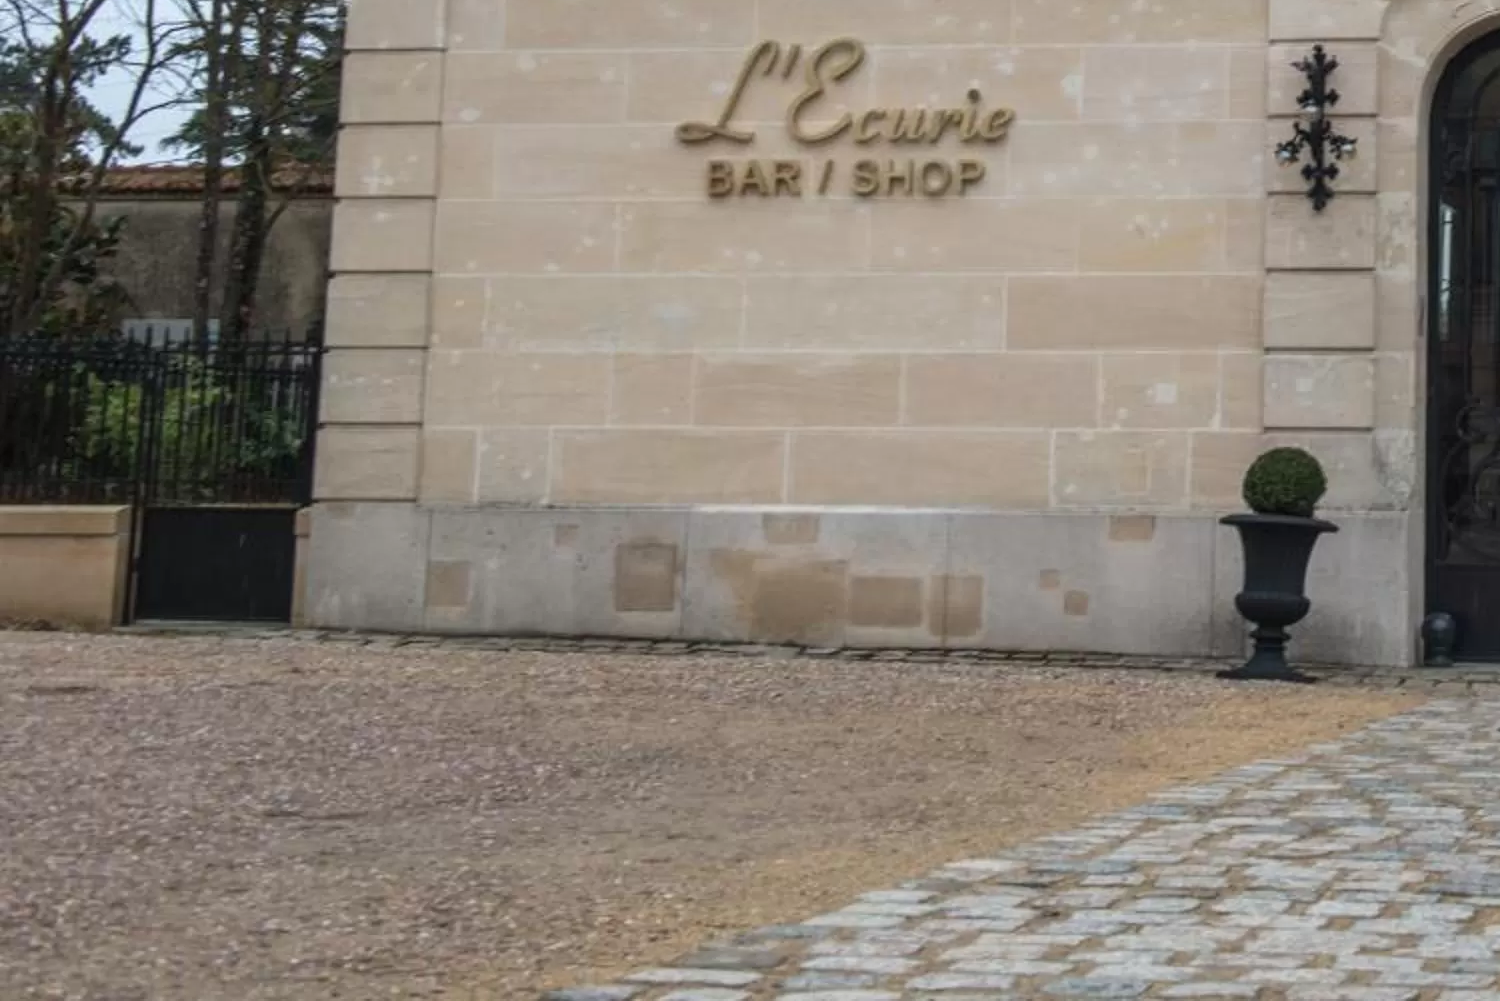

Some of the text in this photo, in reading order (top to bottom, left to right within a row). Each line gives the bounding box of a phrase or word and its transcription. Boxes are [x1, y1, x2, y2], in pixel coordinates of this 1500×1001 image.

[674, 37, 1016, 147] L'Ecurie
[707, 159, 804, 199] BAR
[851, 159, 987, 199] SHOP
